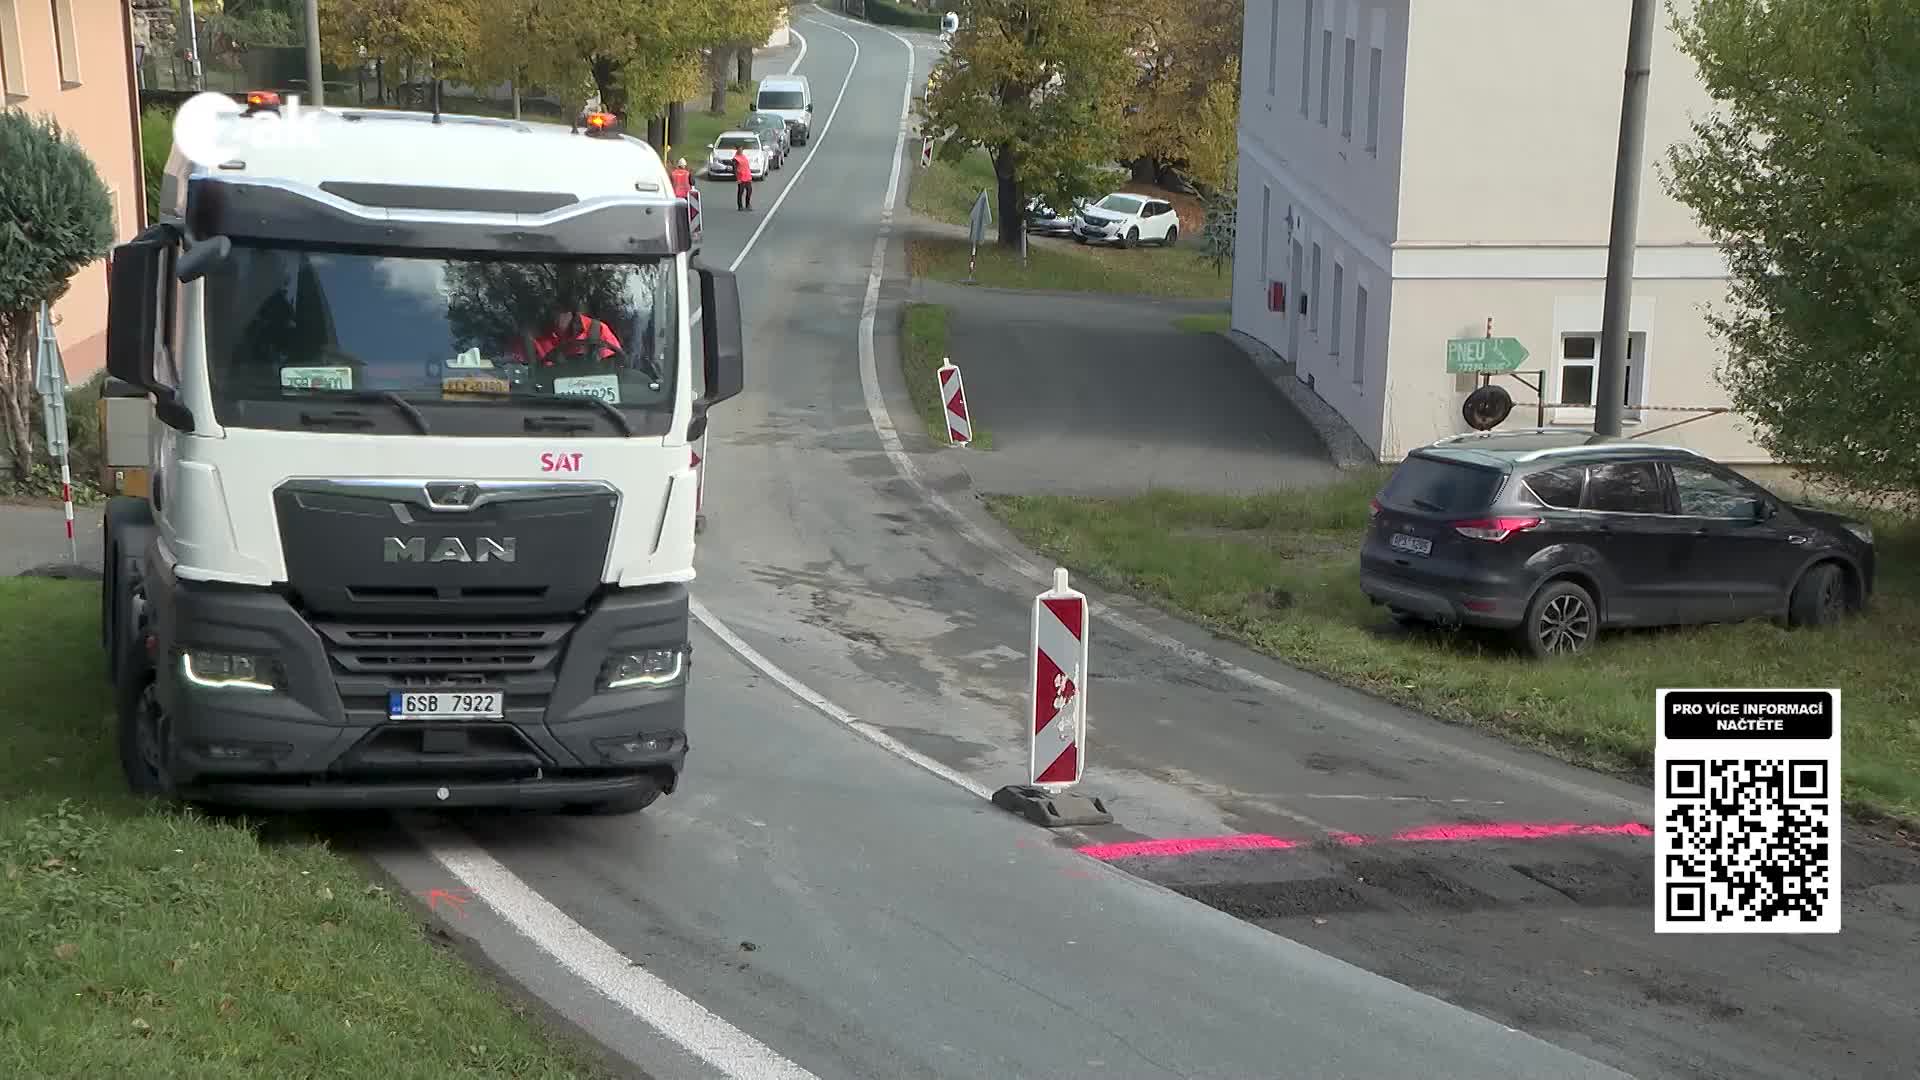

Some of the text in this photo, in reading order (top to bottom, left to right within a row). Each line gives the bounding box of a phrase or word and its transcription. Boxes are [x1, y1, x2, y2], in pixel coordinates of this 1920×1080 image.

[1448, 341, 1486, 362] PNEU
[541, 453, 584, 471] SAT
[383, 536, 517, 562] MAN
[406, 695, 495, 713] 6SB 7922
